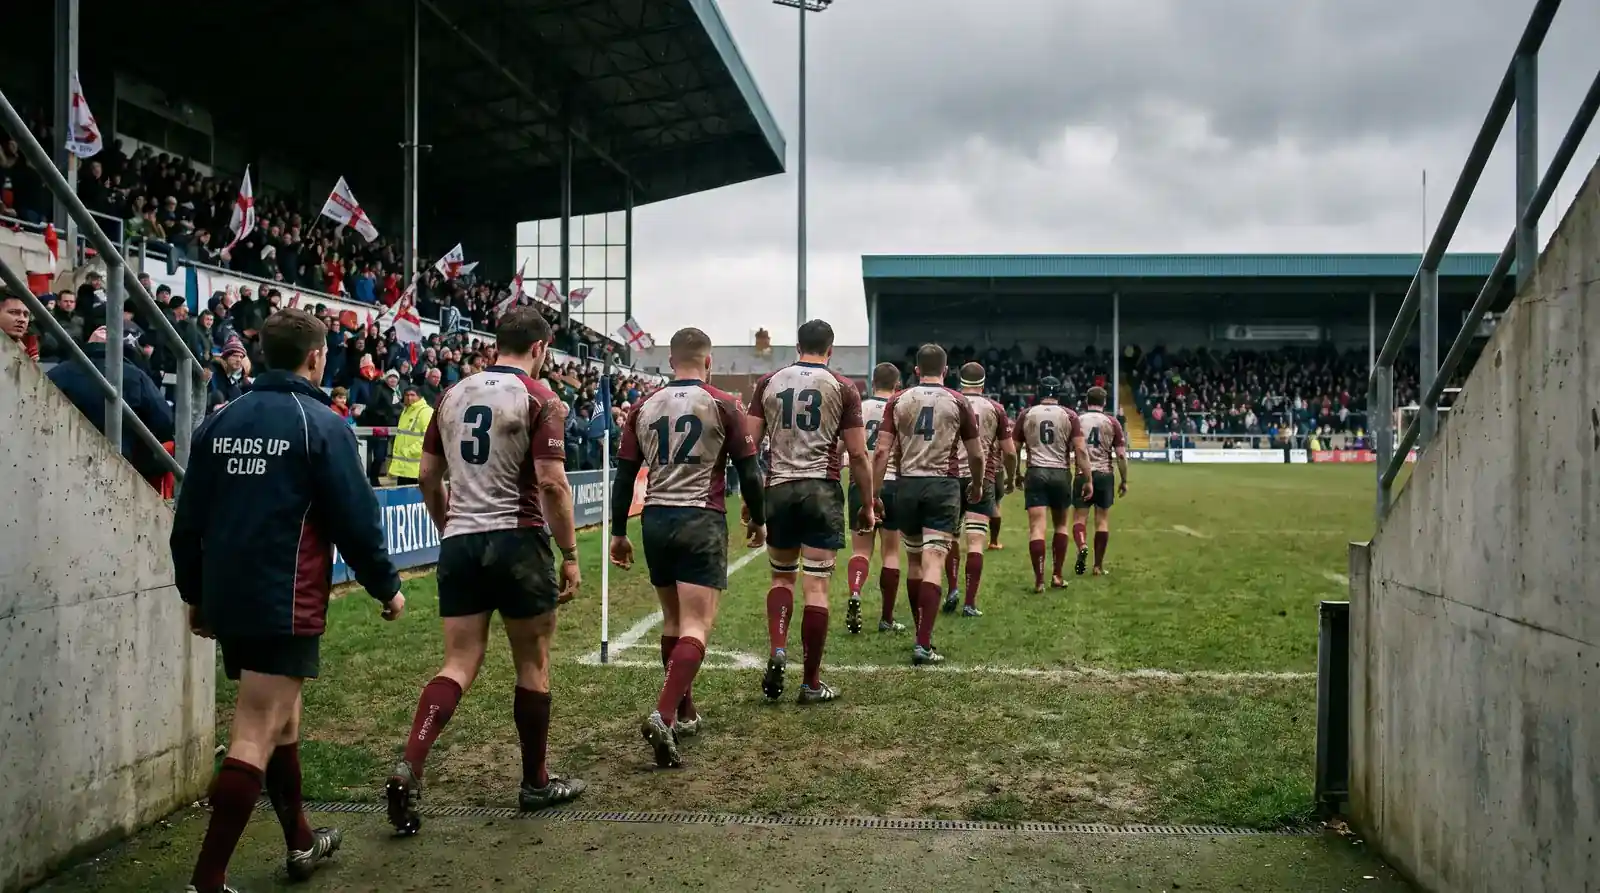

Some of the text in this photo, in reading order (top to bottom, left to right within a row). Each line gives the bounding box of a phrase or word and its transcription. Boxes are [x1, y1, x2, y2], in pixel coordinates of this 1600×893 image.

[776, 388, 822, 432] 13
[914, 406, 935, 441] 4
[212, 437, 291, 457] HEADS UP
[461, 405, 493, 465] 3
[648, 414, 703, 465] 12
[1039, 420, 1055, 445] 6
[1087, 426, 1101, 448] 4
[226, 457, 268, 476] CLUB
